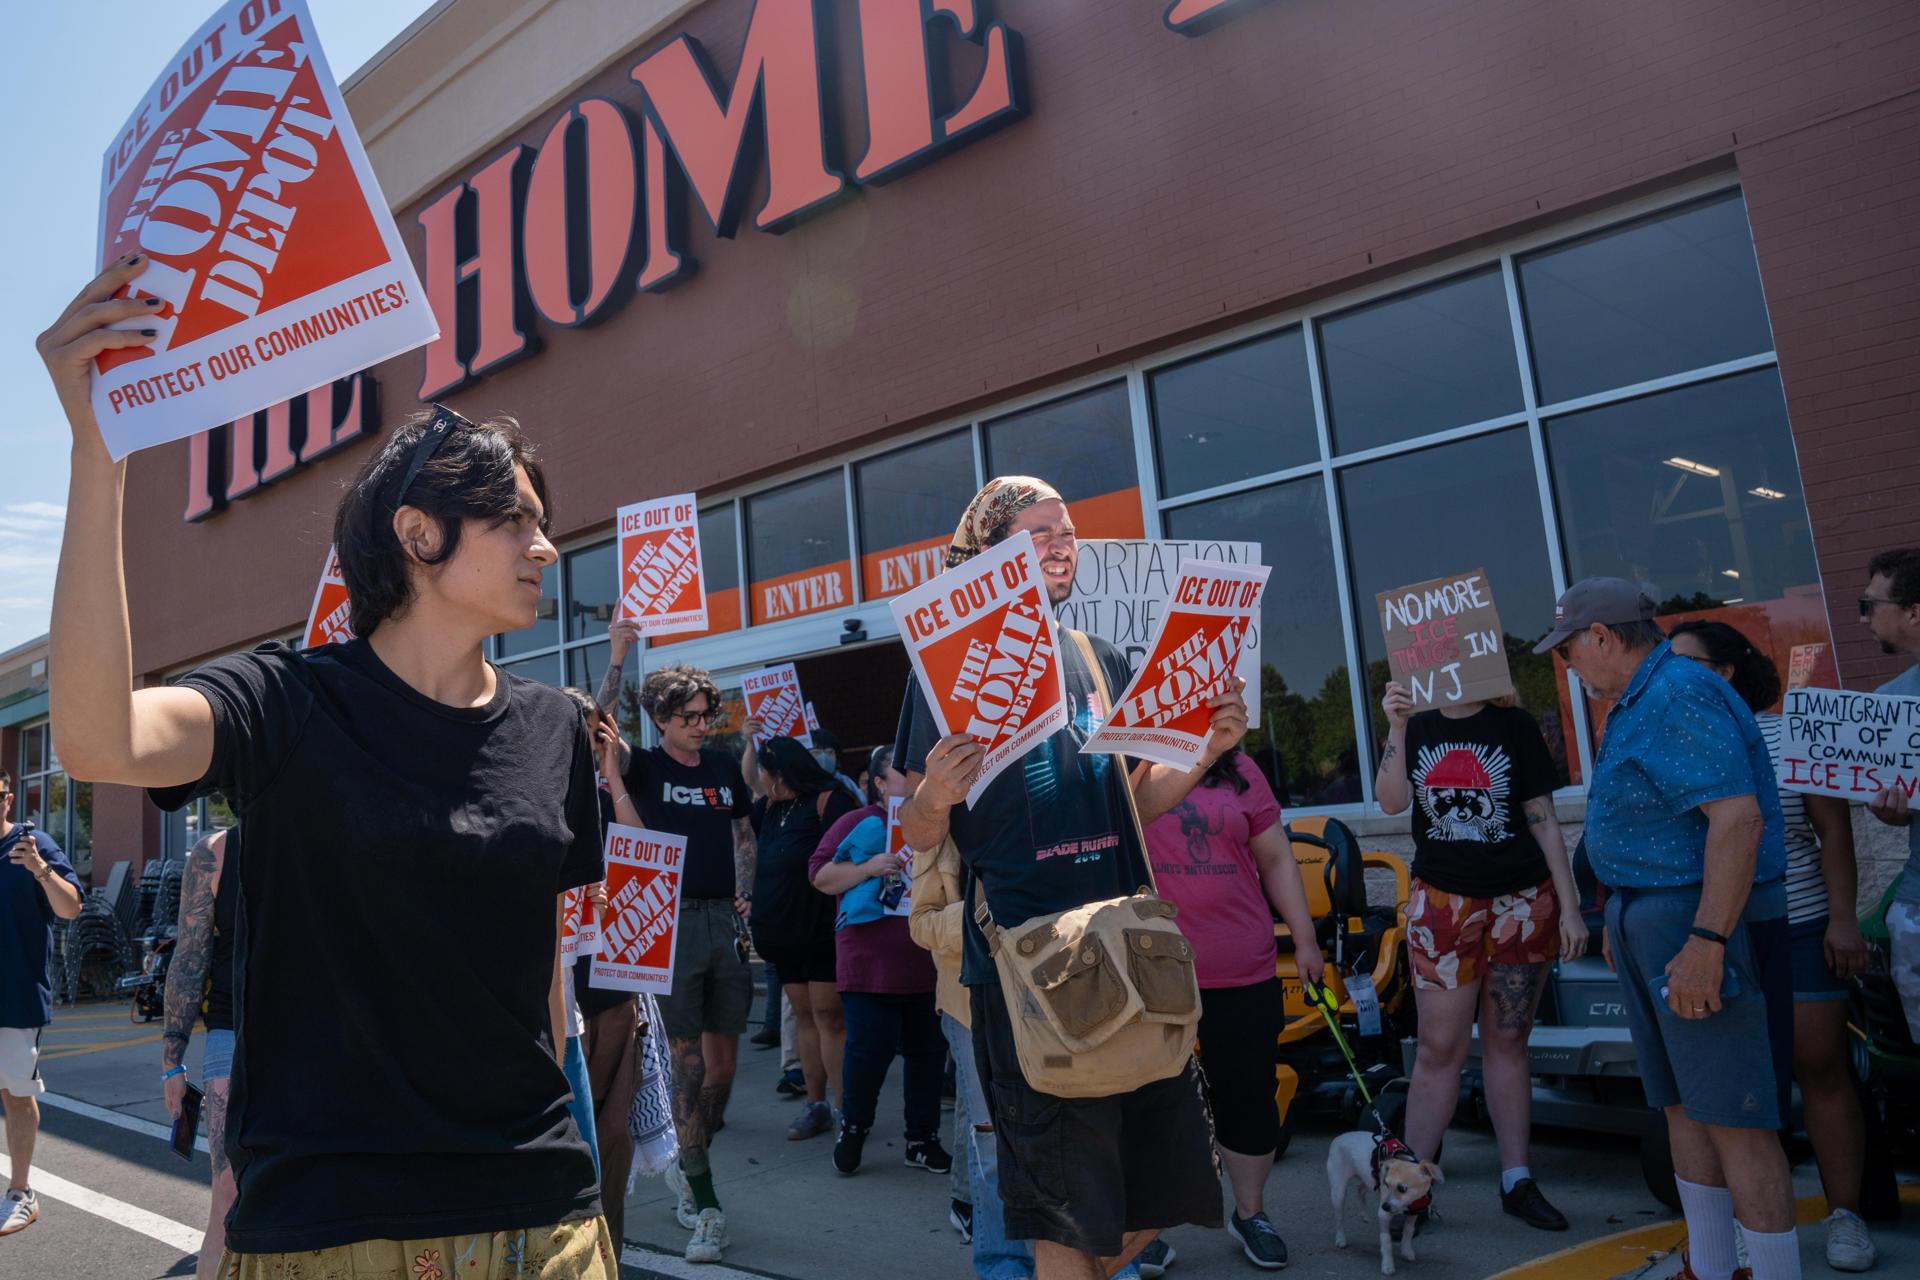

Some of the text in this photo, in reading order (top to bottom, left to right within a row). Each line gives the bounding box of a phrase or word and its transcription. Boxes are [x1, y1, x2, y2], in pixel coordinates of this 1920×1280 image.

[108, 103, 151, 188] ICE
[159, 23, 228, 113] OUT
[114, 126, 194, 245] THE
[200, 94, 335, 319] DEPOT
[413, 0, 1022, 402] HOME
[107, 280, 411, 414] PROTECT OUR COMMUNITIES!
[621, 504, 693, 532] ICE OUT OF
[622, 527, 696, 617] HOME
[627, 540, 658, 575] THE
[879, 544, 951, 593] ENTE
[651, 557, 699, 614] DEPOT
[764, 571, 844, 619] ENTER
[904, 551, 1029, 643] ICE OUT OF
[1174, 575, 1262, 608] ICE OUT OF
[1157, 627, 1207, 676] THE
[1390, 630, 1498, 673] THUGS IN
[1407, 616, 1459, 648] ICE
[744, 669, 794, 691] ICE OUT OF
[949, 638, 993, 703] THE
[1000, 636, 1054, 737] DEPOT
[1122, 616, 1245, 728] HOME
[995, 746, 1010, 763] OUR
[1010, 708, 1063, 751] COMMUNITIES!
[1097, 732, 1200, 753] PROTECT OUR COMMUNITIES!
[1789, 717, 1843, 743] PART
[1858, 727, 1892, 748] OF
[663, 782, 706, 806] ICE
[1783, 758, 1841, 790] ICE
[1848, 766, 1883, 792] IS
[608, 835, 682, 867] ICE OUT OF
[1036, 842, 1080, 861] BLADE
[601, 870, 678, 963] HOME
[610, 875, 643, 914] THE
[624, 907, 675, 966] DEPOT
